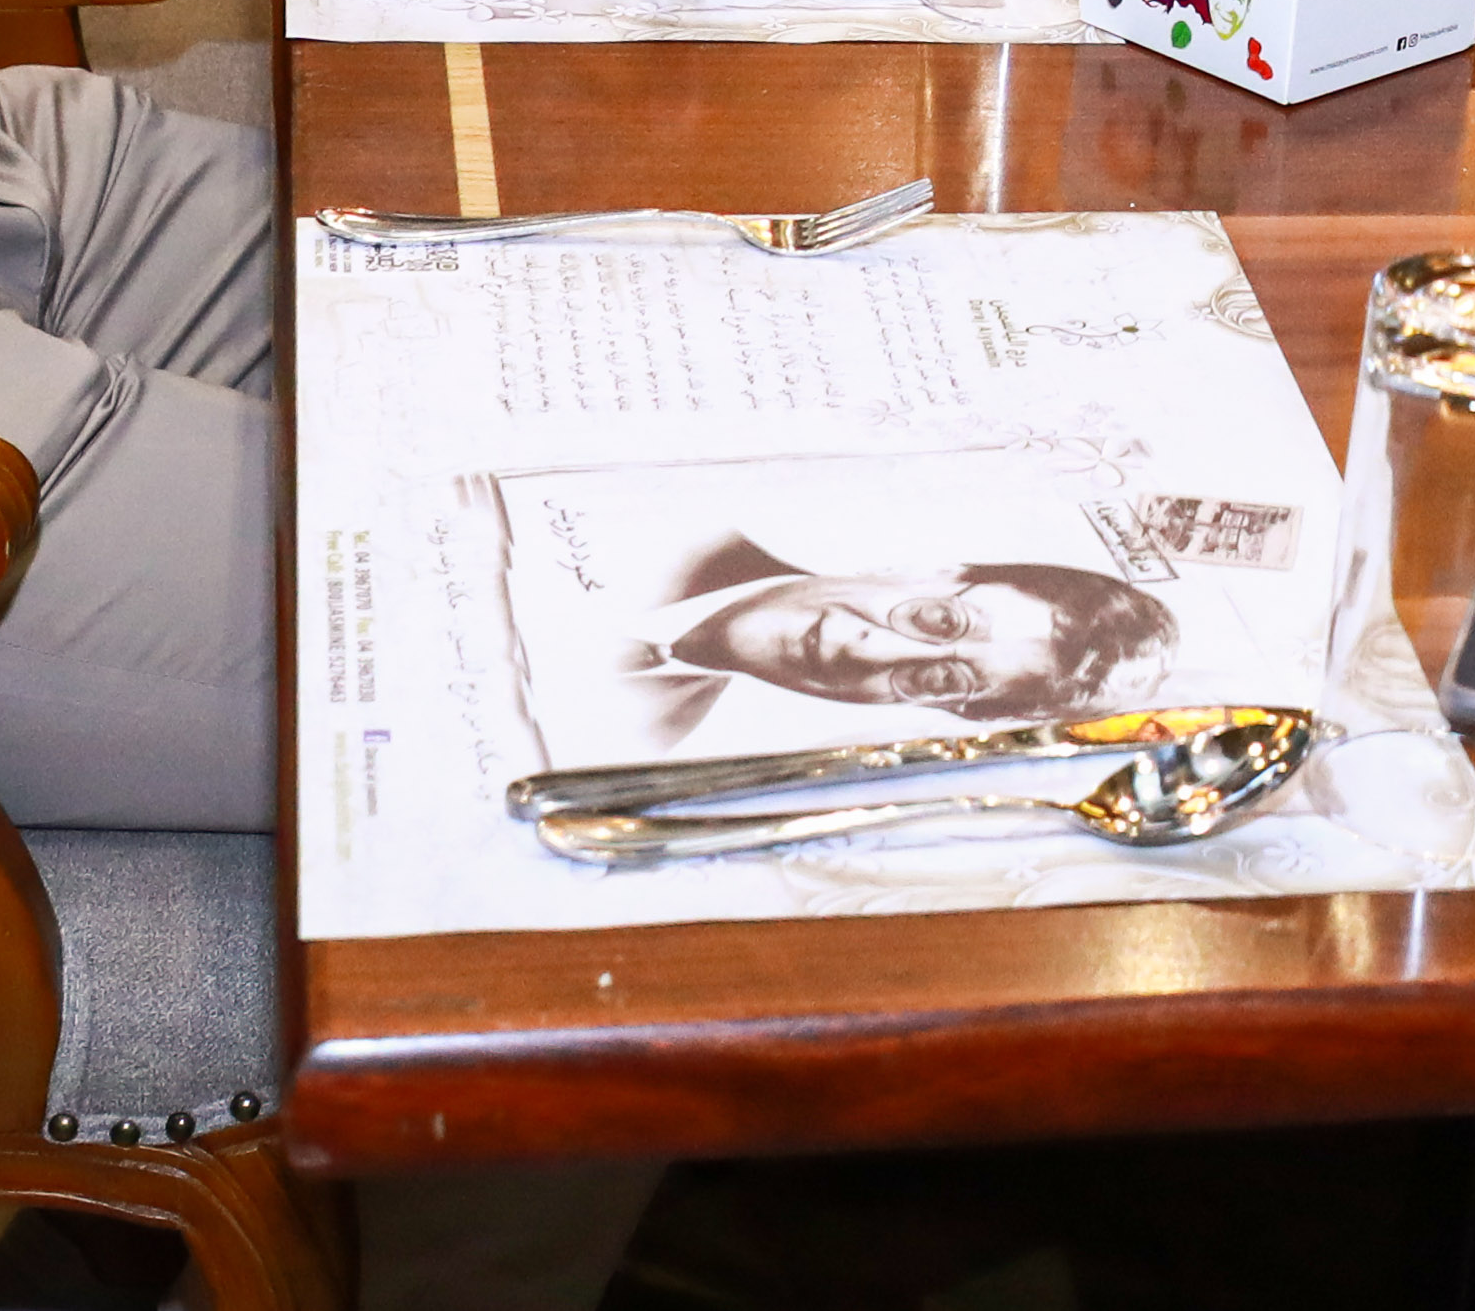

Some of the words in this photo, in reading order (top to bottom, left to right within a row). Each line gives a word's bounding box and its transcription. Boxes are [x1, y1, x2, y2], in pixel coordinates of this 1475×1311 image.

[354, 551, 371, 564] 04
[555, 551, 606, 593] محمود
[356, 640, 374, 653] 04
